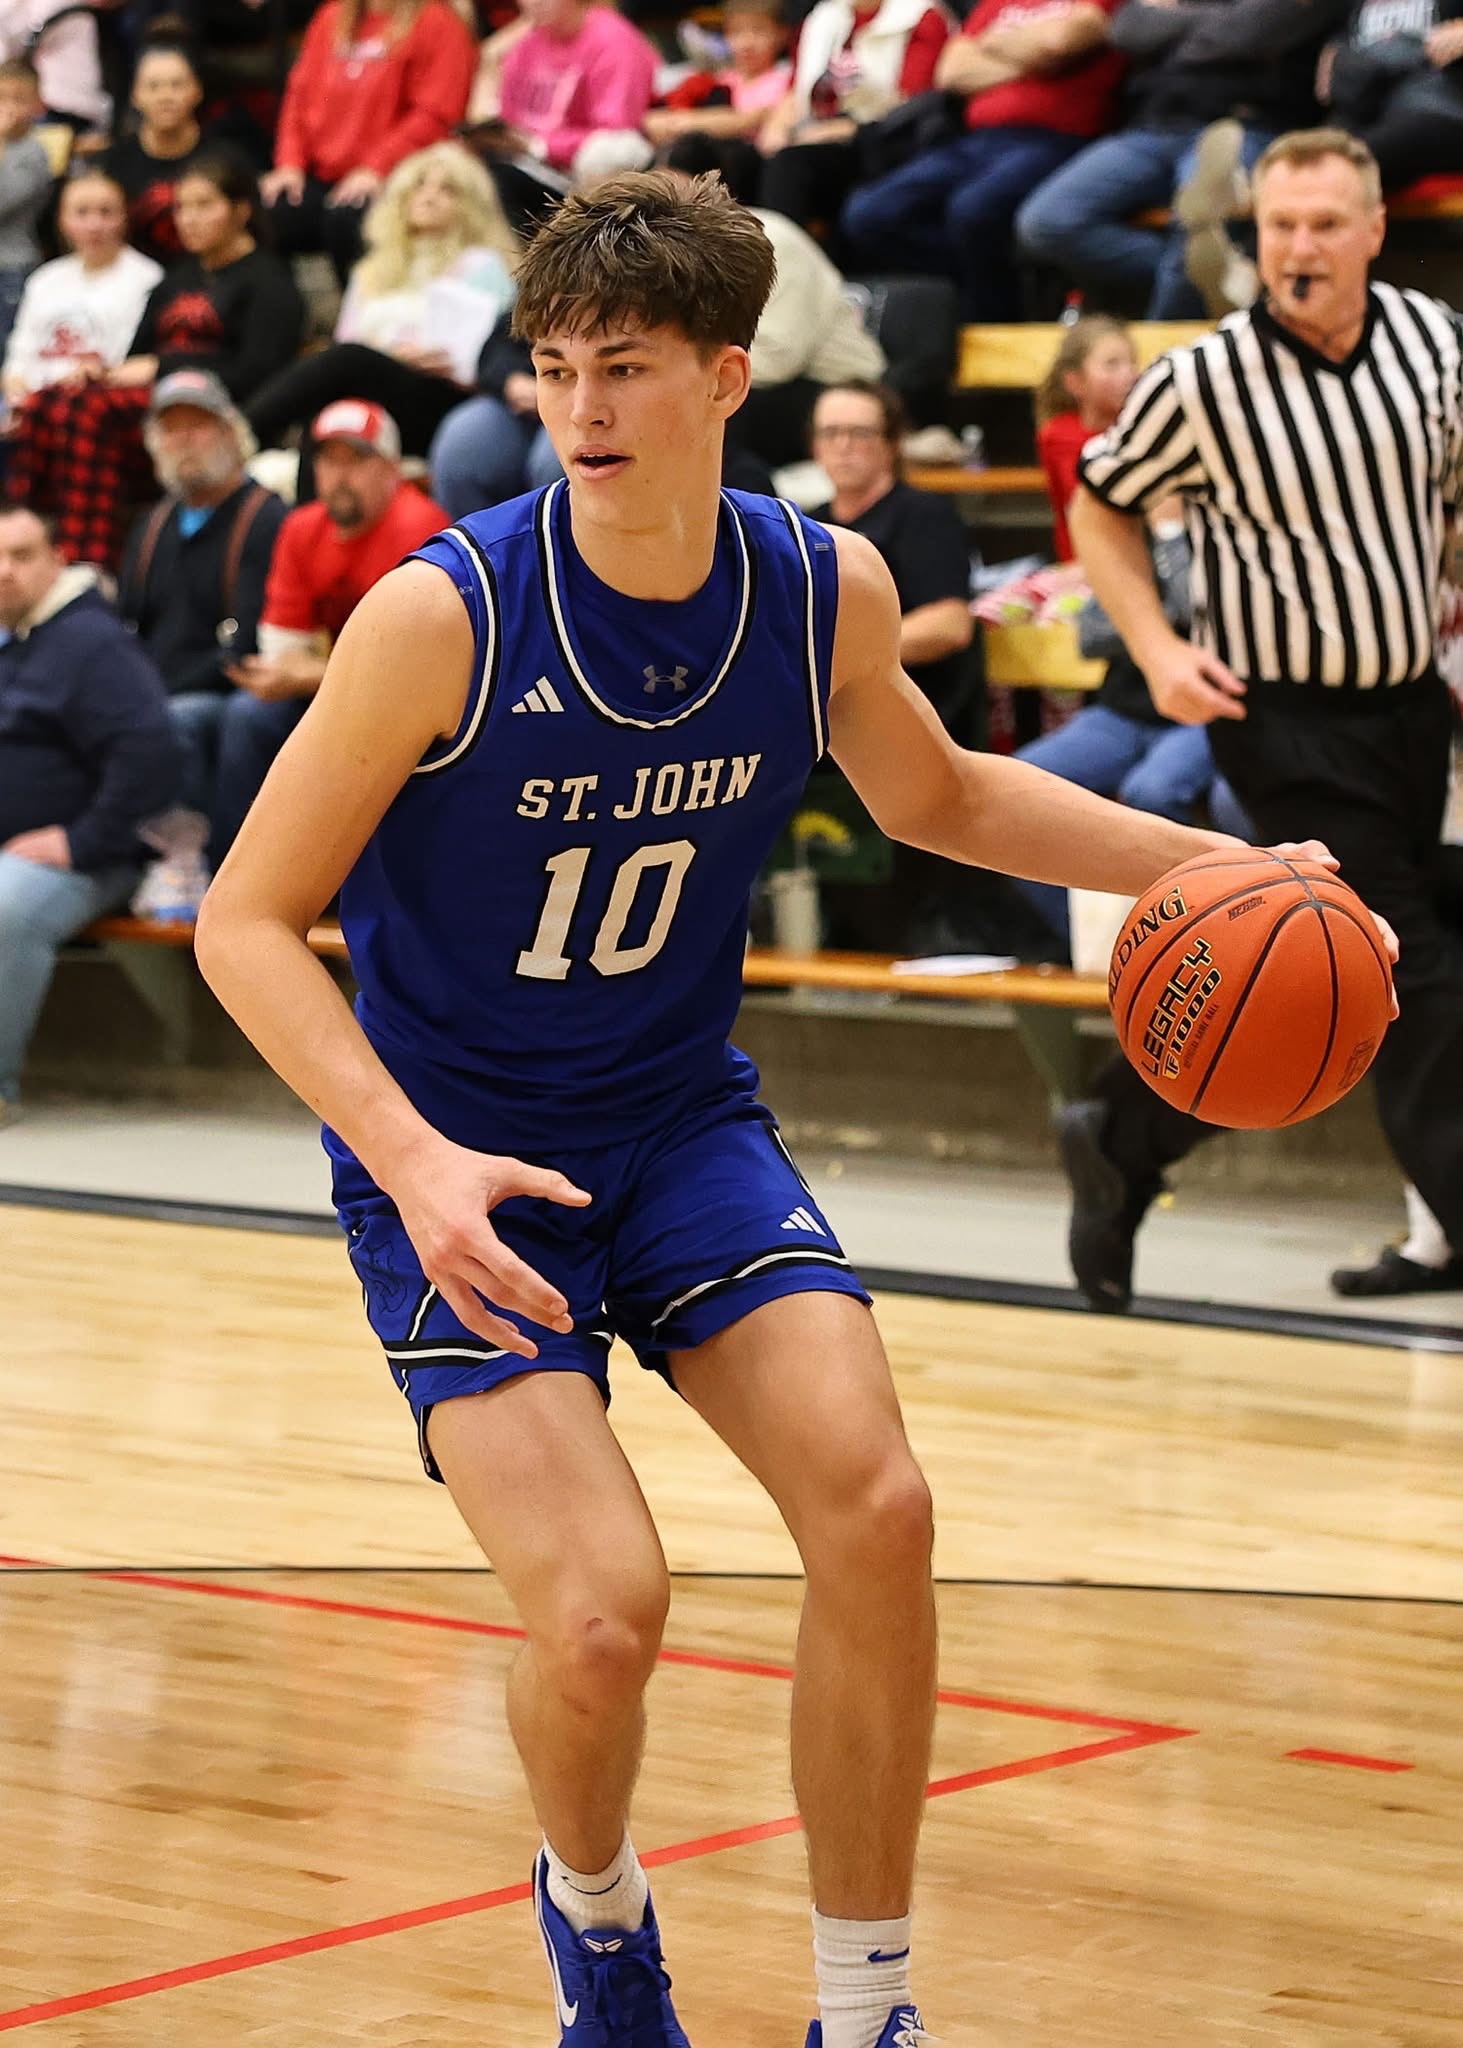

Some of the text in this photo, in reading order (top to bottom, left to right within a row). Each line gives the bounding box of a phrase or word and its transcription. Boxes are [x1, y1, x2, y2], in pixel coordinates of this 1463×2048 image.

[516, 753, 762, 821] ST. JOHN
[515, 839, 697, 980] 10
[1141, 937, 1213, 1077] LEGACY
